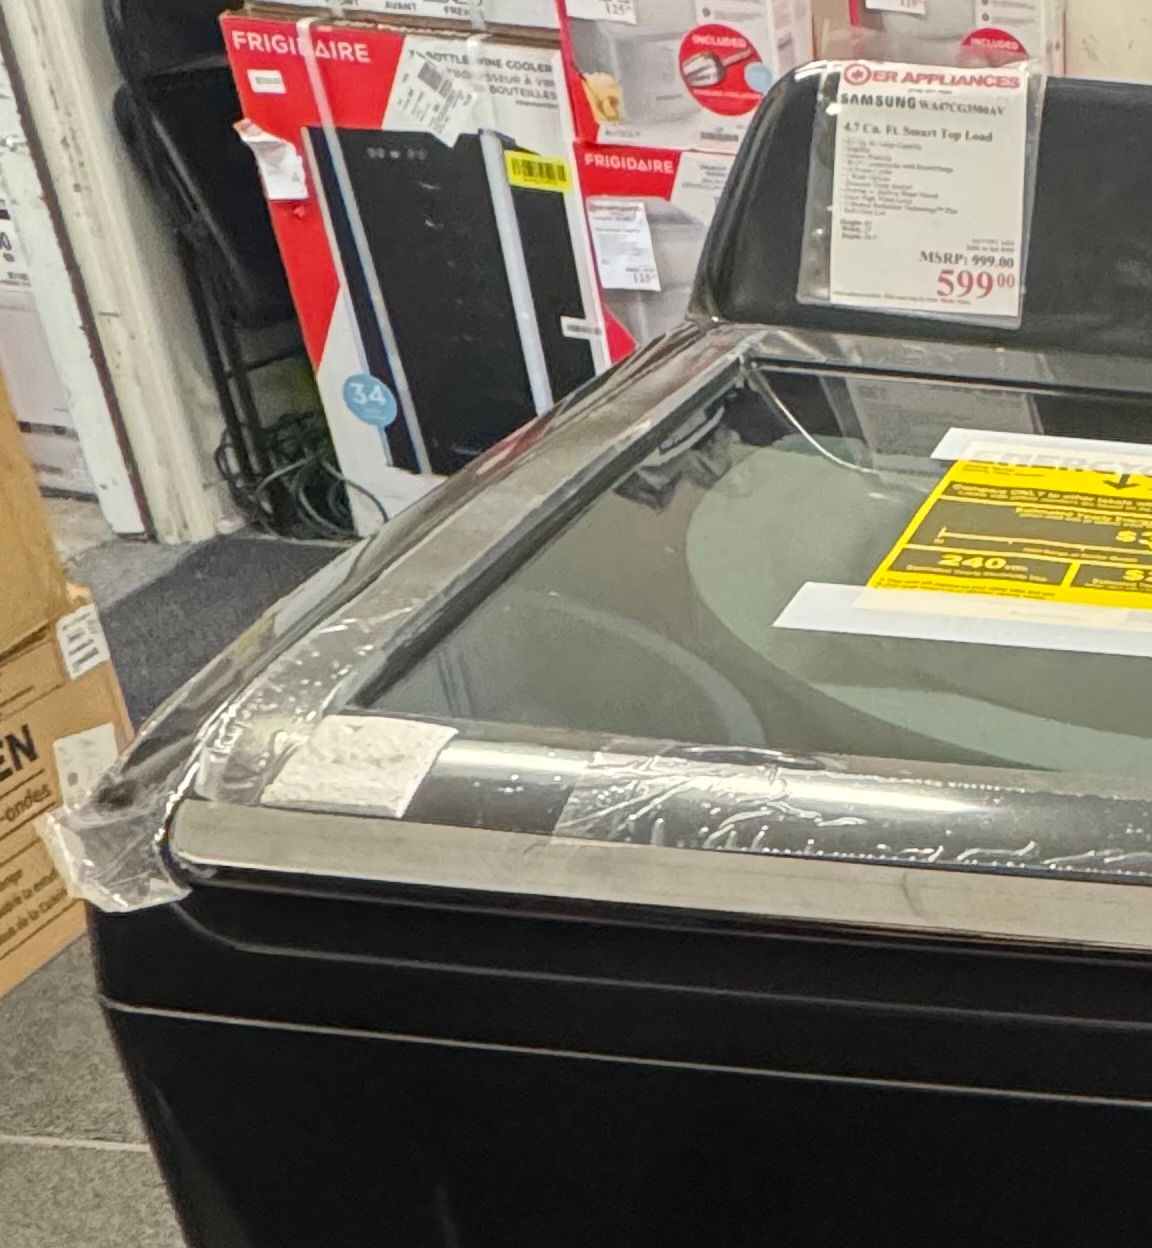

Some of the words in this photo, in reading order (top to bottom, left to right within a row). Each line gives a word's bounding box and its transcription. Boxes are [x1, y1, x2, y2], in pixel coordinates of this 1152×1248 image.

[232, 30, 371, 63] FRIGIAIRE
[902, 72, 1021, 89] APPLIANCES
[841, 92, 916, 110] SAMSUNG
[941, 128, 962, 142] Top
[965, 130, 993, 142] Load
[584, 153, 674, 174] FRIGIDAIRE
[920, 250, 968, 266] MSRP:
[972, 254, 1014, 268] 999.00
[937, 268, 993, 299] 599
[937, 553, 1006, 571] 240
